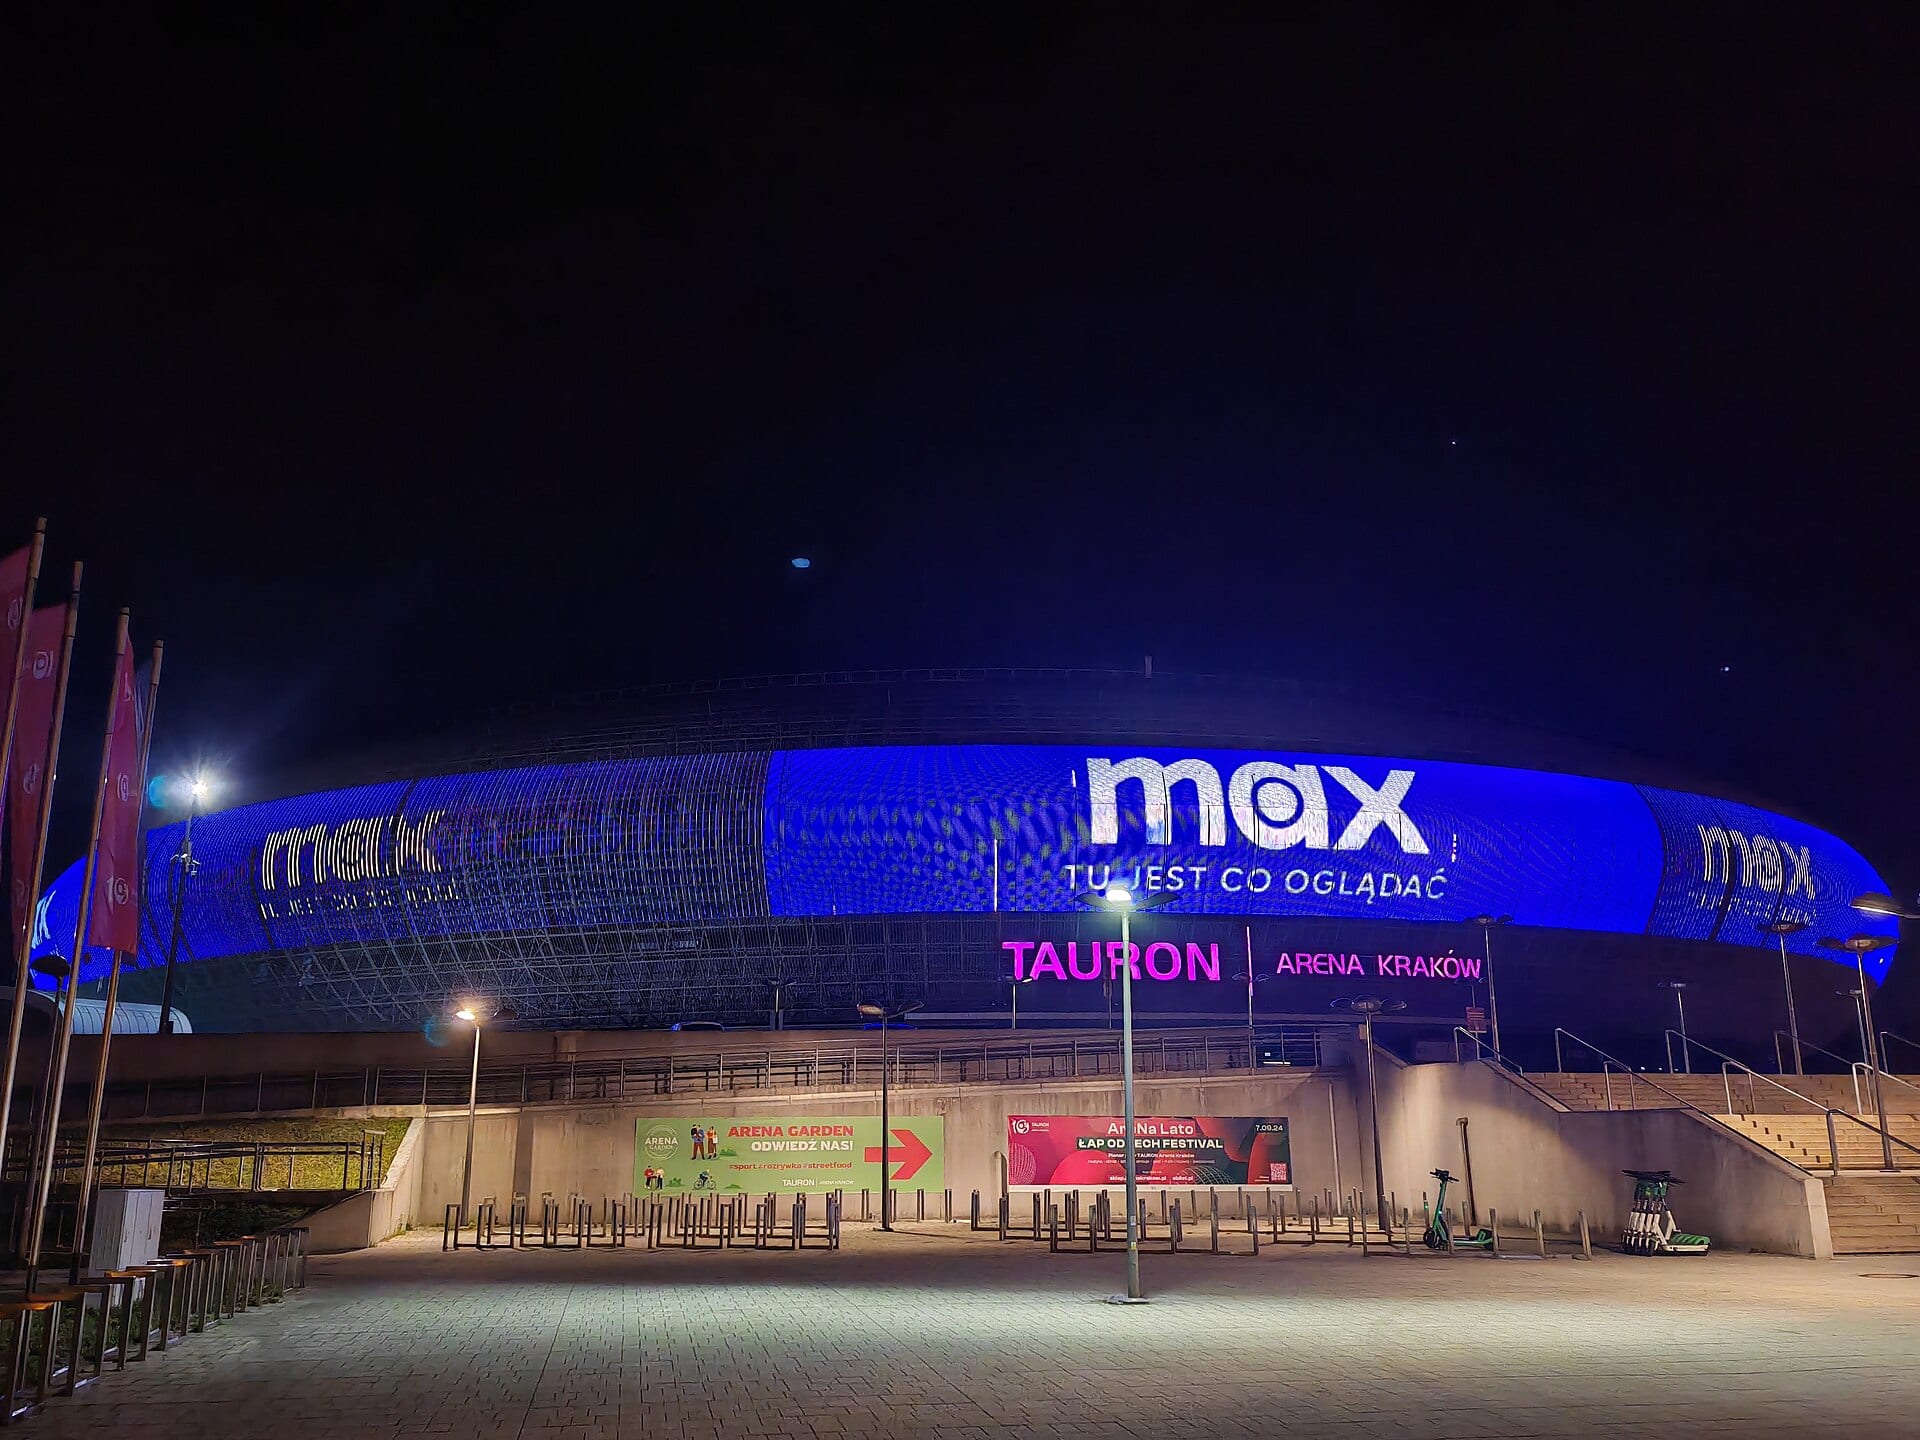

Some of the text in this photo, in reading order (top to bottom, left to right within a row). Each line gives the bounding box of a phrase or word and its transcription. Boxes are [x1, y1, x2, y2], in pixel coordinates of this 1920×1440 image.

[1087, 757, 1429, 854] max
[1064, 864, 1447, 904] TU JEST CO OGLĄDAĆ
[1002, 941, 1481, 981] TAURON ARENA KRAKÓW
[728, 1125, 854, 1137] ARENA GARDEN
[1107, 1122, 1194, 1135] ArNa Lato
[644, 1137, 679, 1145] ARENA
[751, 1139, 853, 1151] ODWIEDŹ NAS!
[1078, 1138, 1105, 1149] ŁAP
[1107, 1138, 1125, 1149] OD
[1163, 1138, 1224, 1149] FESTIVAL
[782, 1179, 815, 1187] TAURON
